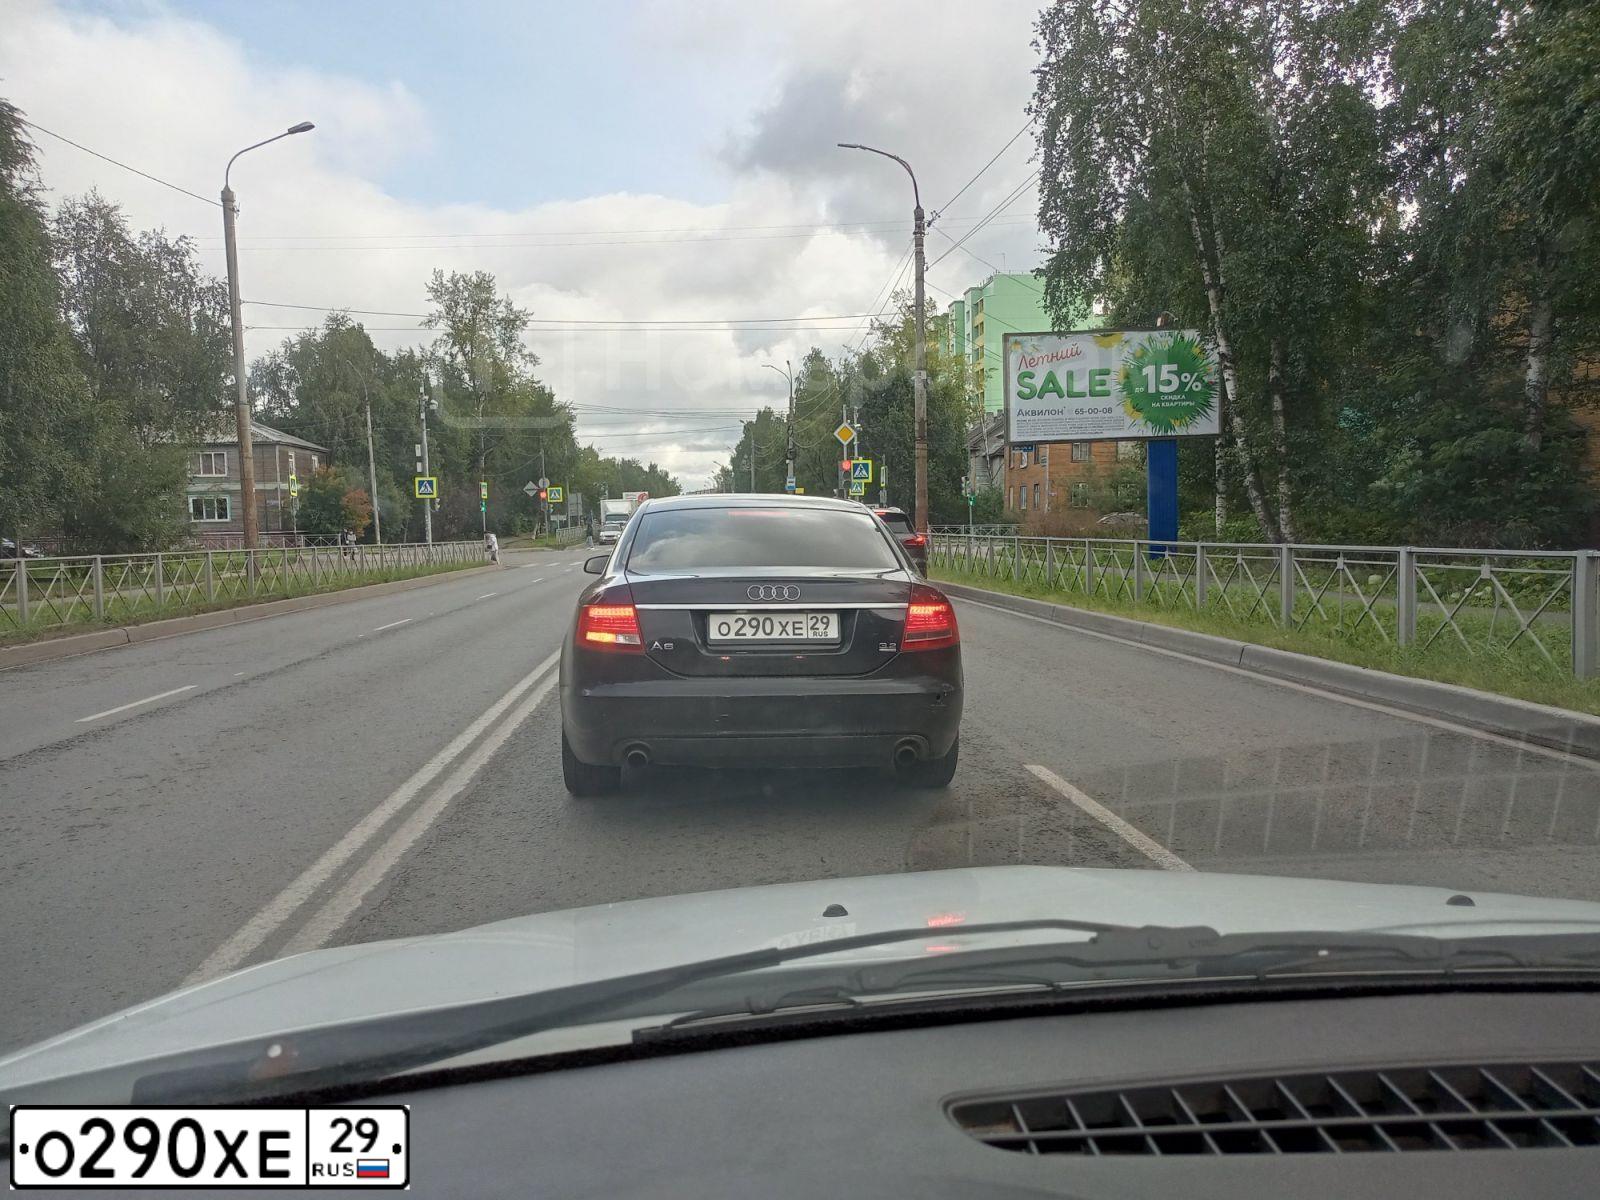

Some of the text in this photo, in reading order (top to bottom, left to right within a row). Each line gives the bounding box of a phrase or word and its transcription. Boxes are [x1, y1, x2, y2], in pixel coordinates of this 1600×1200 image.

[1018, 342, 1082, 371] Летний
[1017, 368, 1111, 400] SALE
[1142, 363, 1202, 394] 15%
[1074, 407, 1113, 415] 65-00-08
[809, 615, 830, 631] 29
[650, 641, 674, 651] A6
